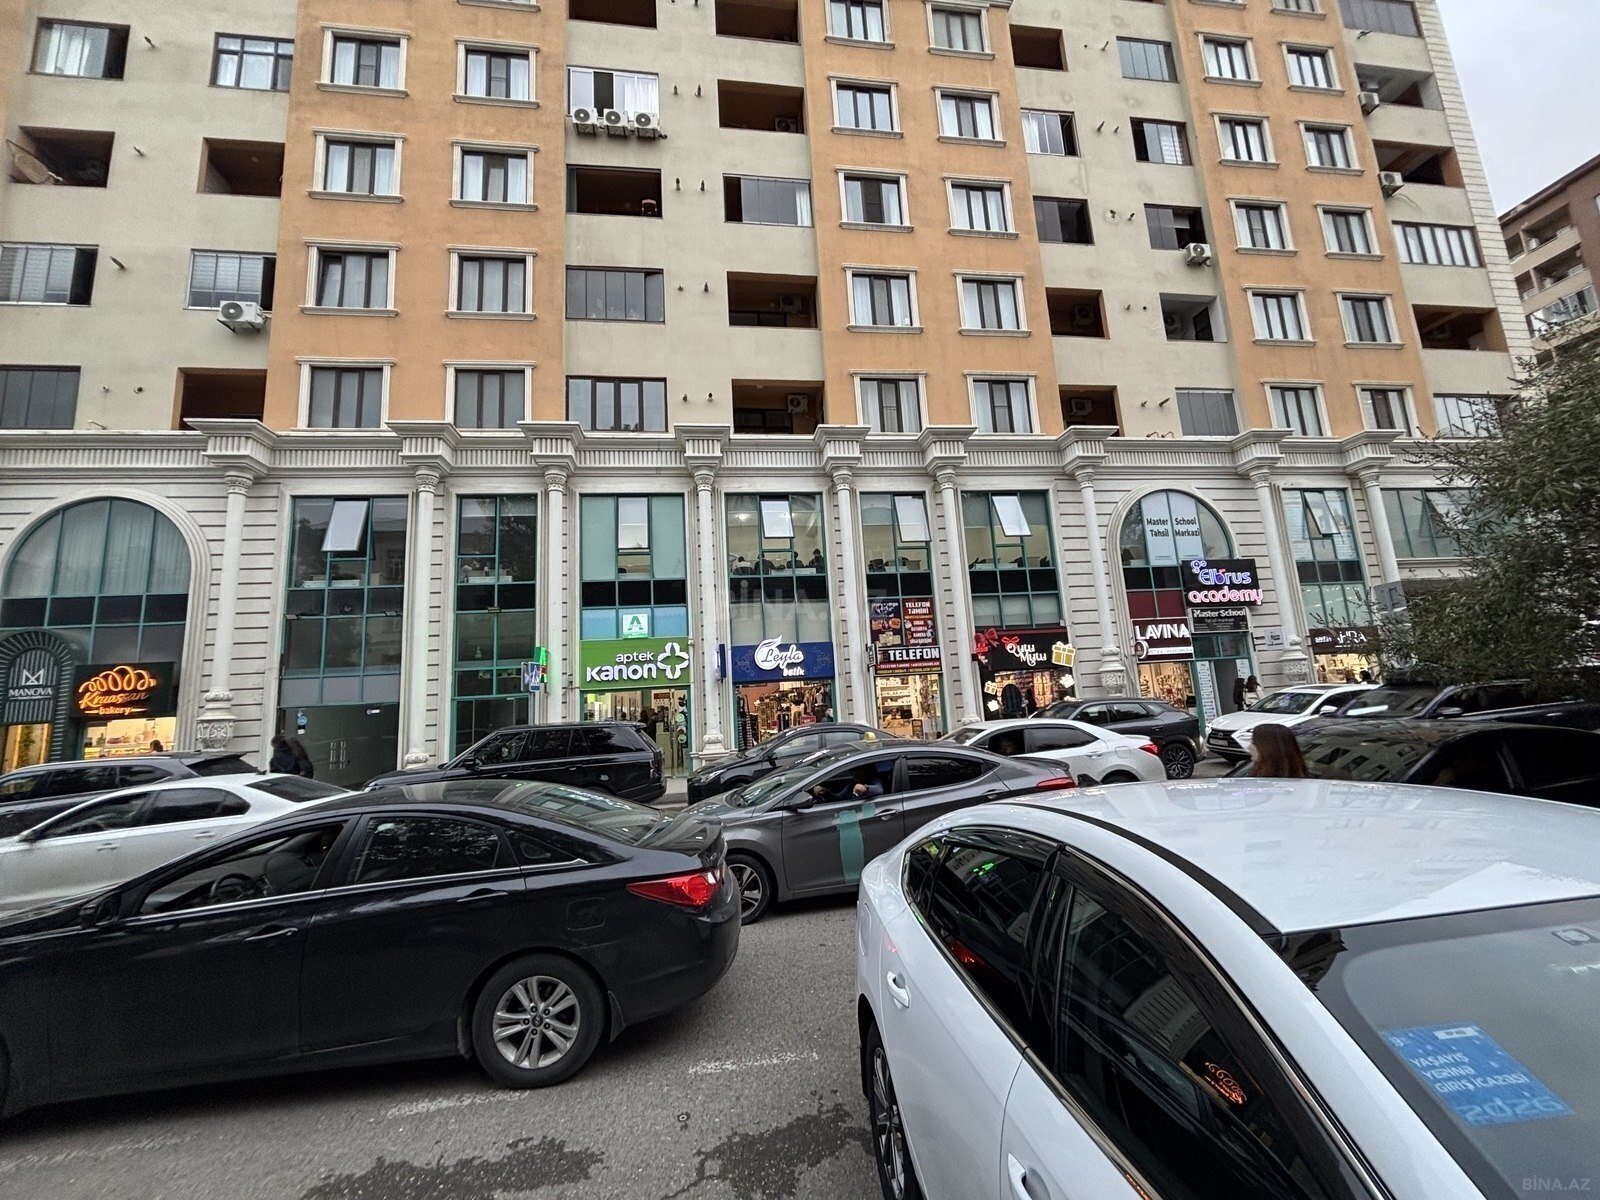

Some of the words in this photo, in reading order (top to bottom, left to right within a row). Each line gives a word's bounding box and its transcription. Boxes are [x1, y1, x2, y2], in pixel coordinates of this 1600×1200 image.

[1146, 517, 1169, 526] Master
[1174, 517, 1197, 526] School
[1188, 586, 1264, 605] academy
[1193, 609, 1219, 618] Master
[1219, 608, 1246, 617] School
[1134, 623, 1191, 640] LAVINA
[615, 651, 654, 664] aptek
[760, 645, 804, 667] Leyla
[888, 647, 940, 661] TELEFON
[8, 687, 53, 697] MANOVA
[99, 706, 132, 716] bakery
